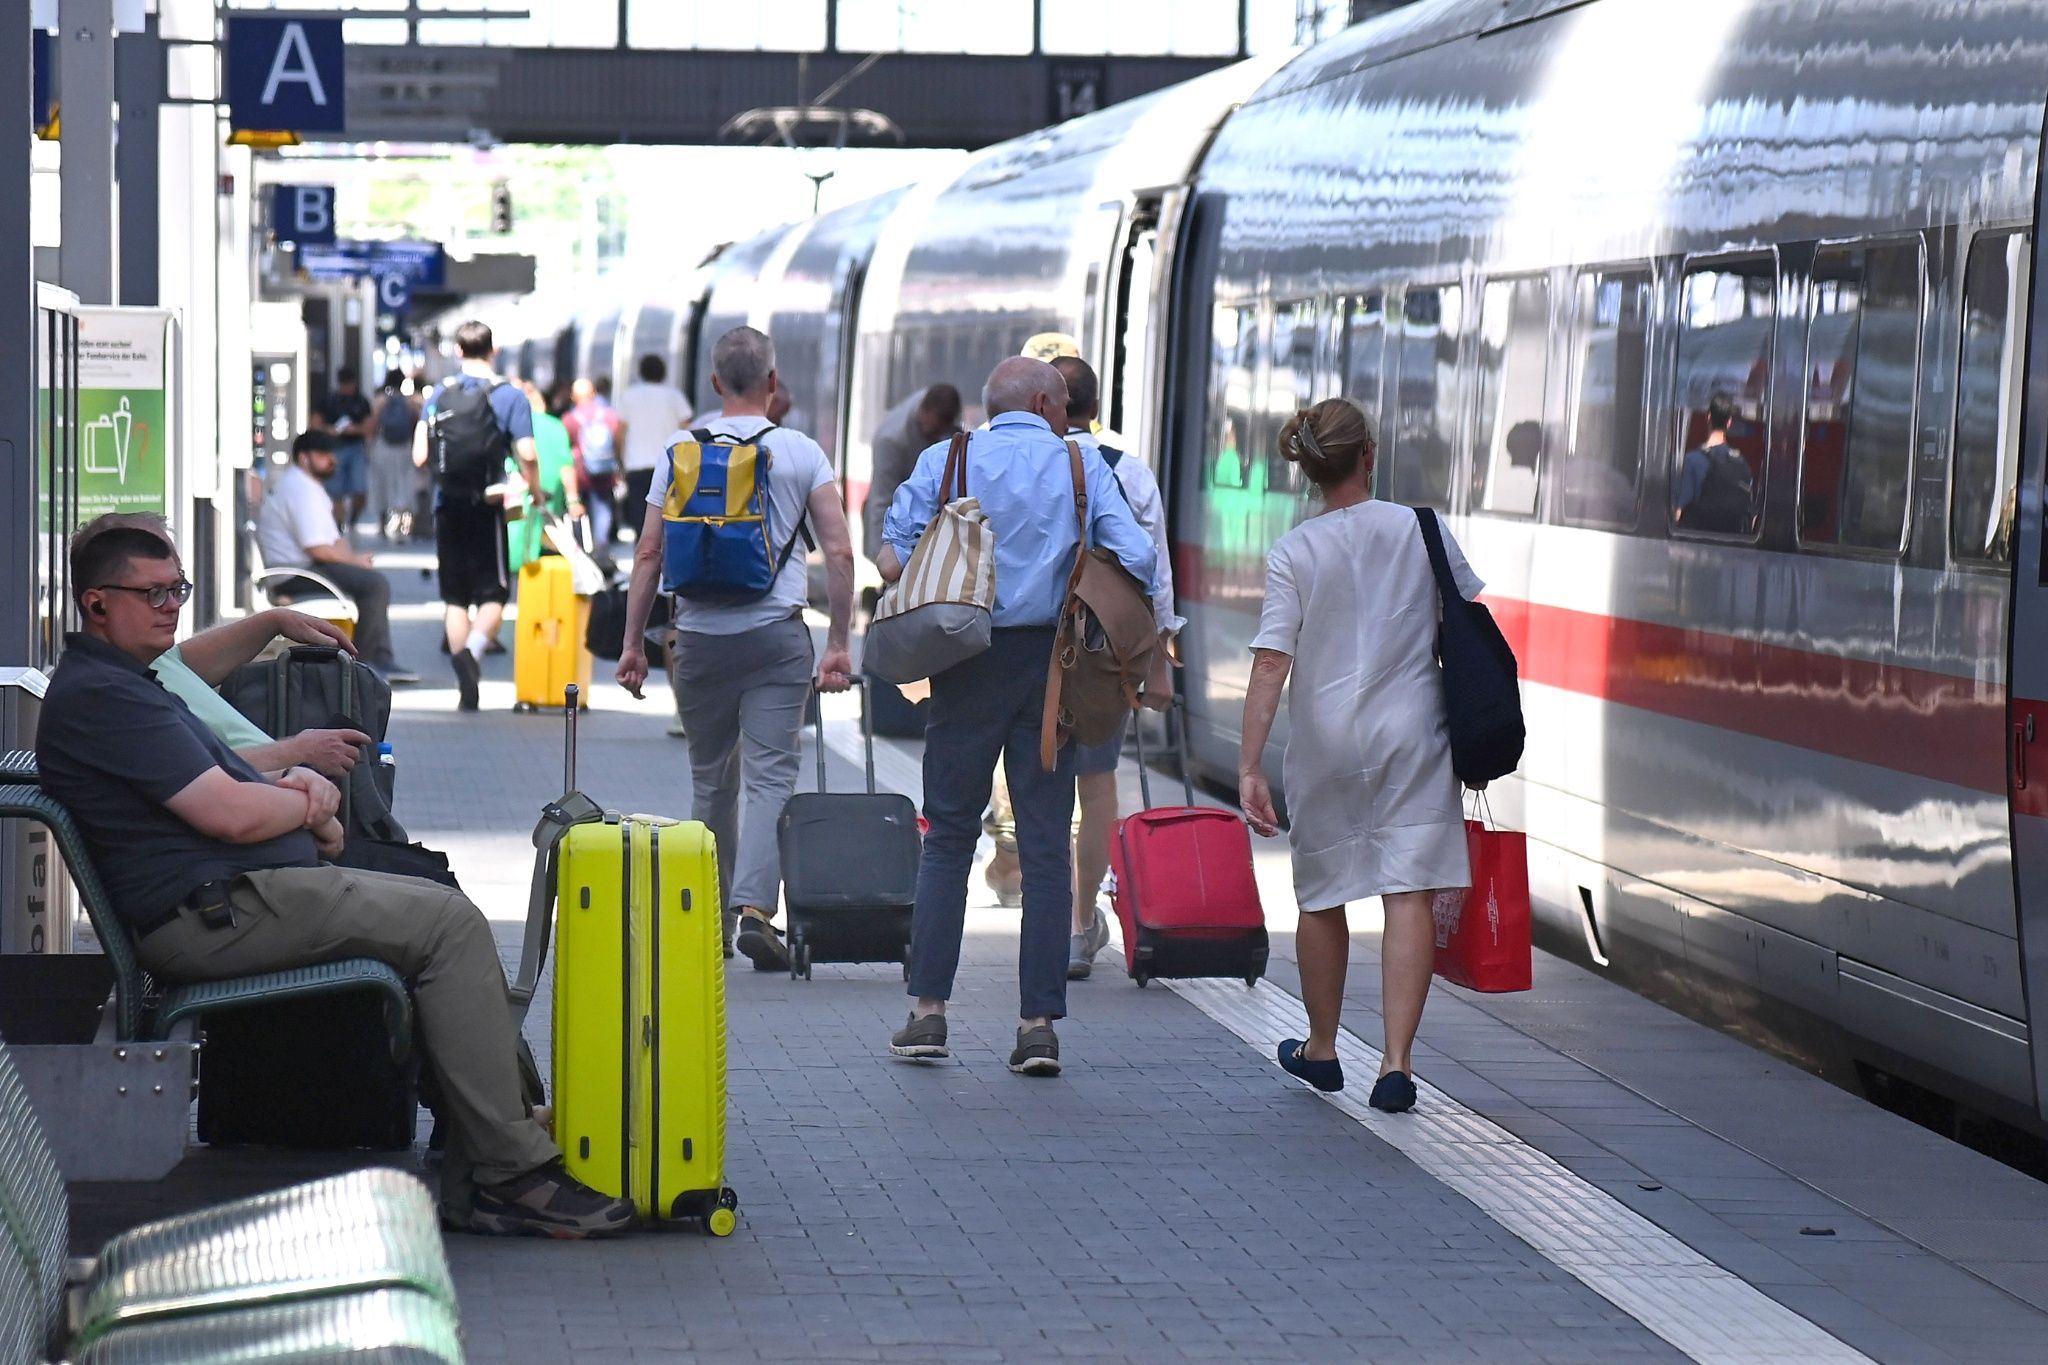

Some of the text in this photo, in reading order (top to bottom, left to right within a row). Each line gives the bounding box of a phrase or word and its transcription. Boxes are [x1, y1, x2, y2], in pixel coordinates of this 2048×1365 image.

[261, 22, 327, 106] A
[294, 187, 331, 233] B
[380, 272, 406, 308] C
[27, 820, 47, 954] bfal
